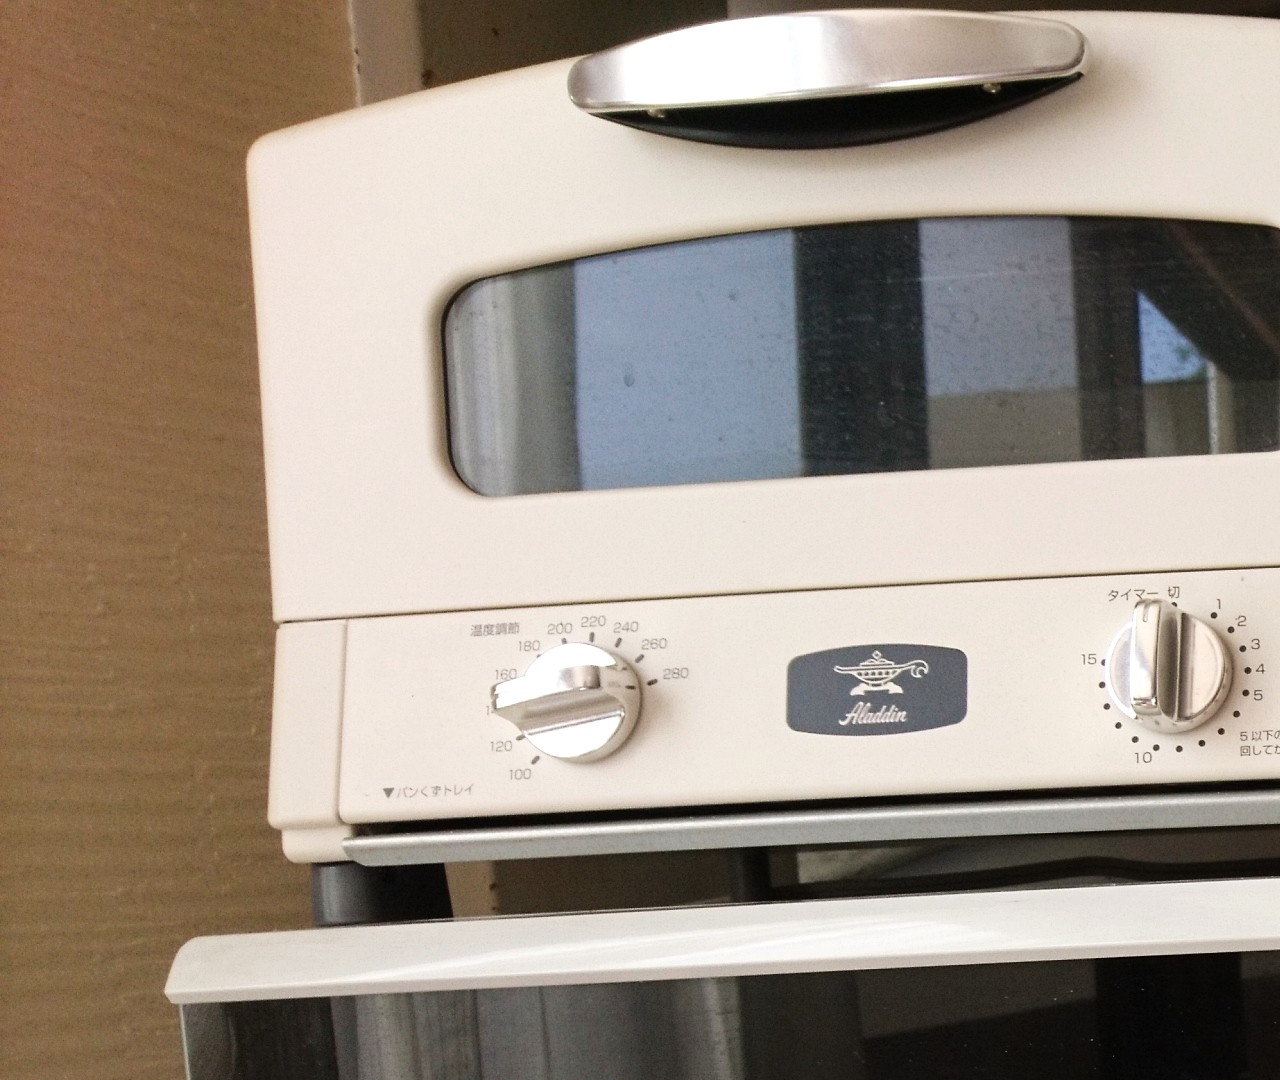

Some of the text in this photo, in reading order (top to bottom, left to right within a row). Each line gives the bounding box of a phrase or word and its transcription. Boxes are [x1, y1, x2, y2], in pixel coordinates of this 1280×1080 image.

[1107, 588, 1160, 602] タイマー
[1166, 586, 1181, 600] 切
[580, 615, 607, 628] 220
[1237, 614, 1247, 627] 2
[470, 622, 520, 637] 温度調節
[546, 622, 574, 635] 200
[612, 621, 640, 634] 240
[518, 640, 541, 652] 180
[640, 638, 668, 650] 260
[1250, 638, 1261, 650] 3
[1081, 653, 1098, 665] 15
[493, 667, 518, 681] 160
[662, 667, 690, 680] 280
[1255, 664, 1266, 673] 4
[1253, 689, 1264, 701] 5
[838, 702, 907, 725] Aladdin
[489, 740, 513, 752] 120
[1134, 752, 1153, 764] 10
[509, 768, 532, 781] 100
[396, 784, 474, 798] パンくずトレイ
